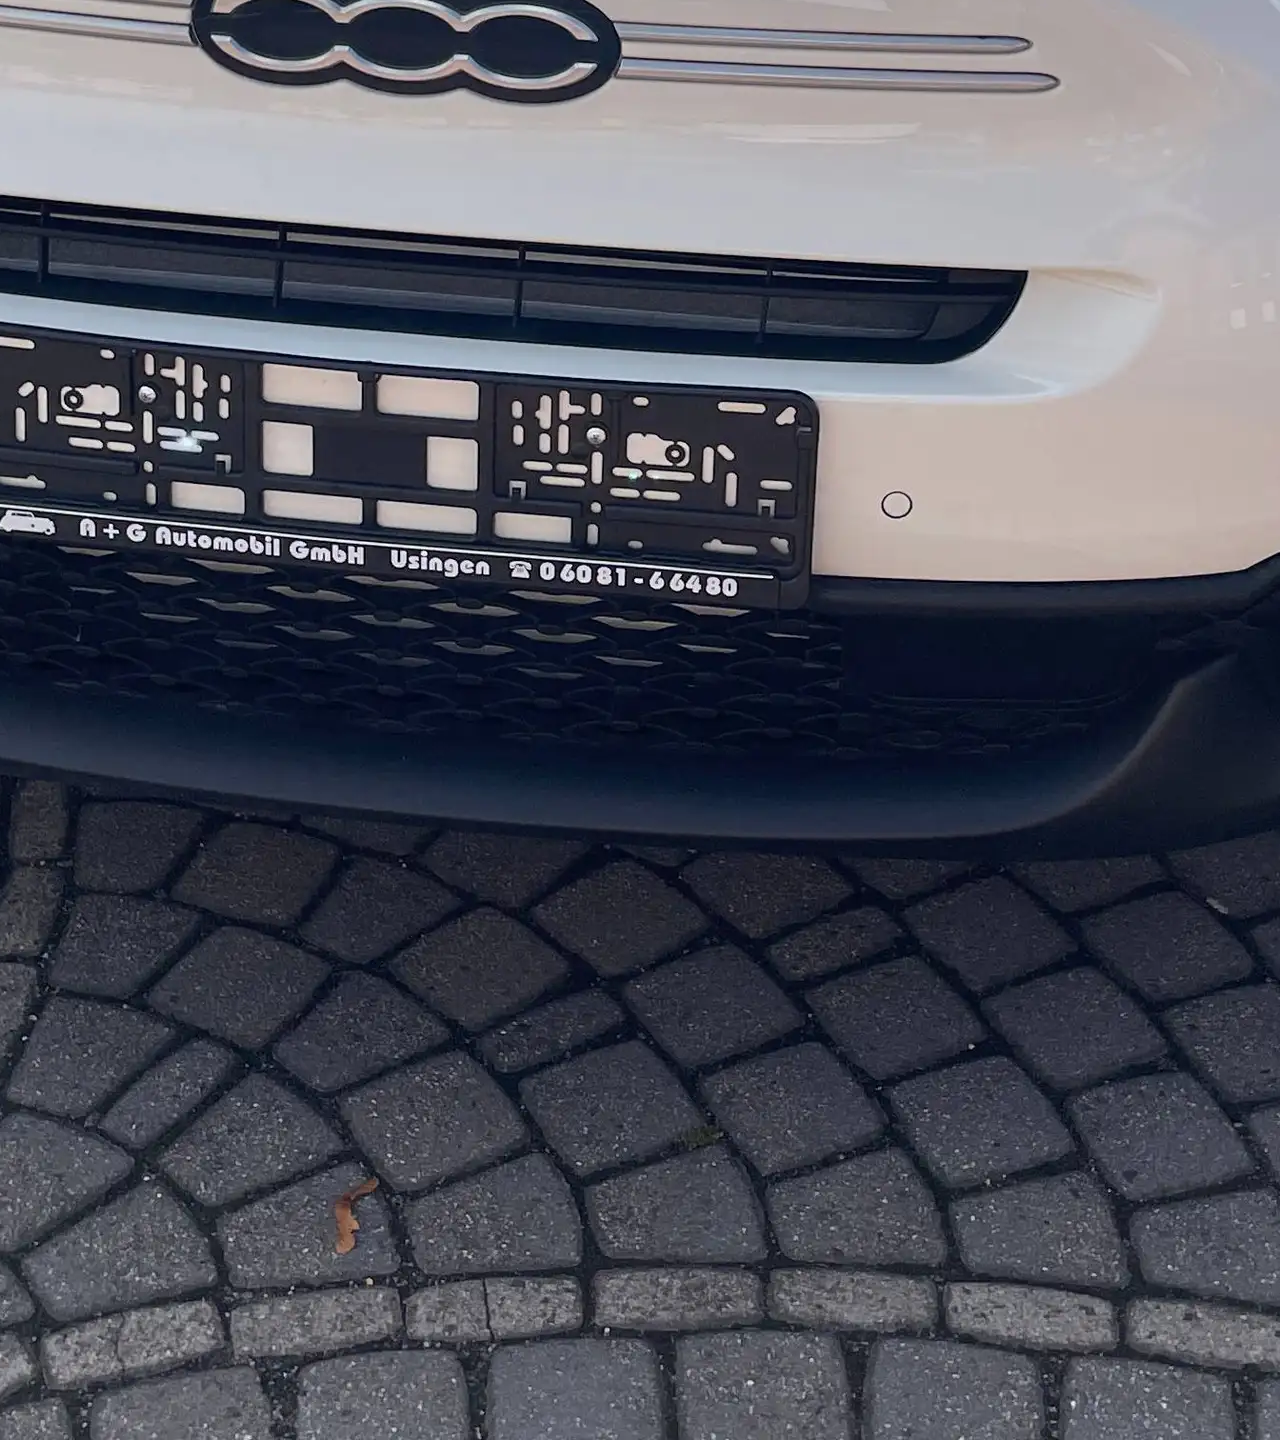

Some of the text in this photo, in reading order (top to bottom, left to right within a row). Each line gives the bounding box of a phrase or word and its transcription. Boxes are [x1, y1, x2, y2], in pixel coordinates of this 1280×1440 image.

[79, 518, 96, 538] A
[126, 523, 147, 543] G
[155, 526, 281, 557] Automobil
[289, 540, 365, 565] GmbH
[390, 549, 490, 578] Usingen
